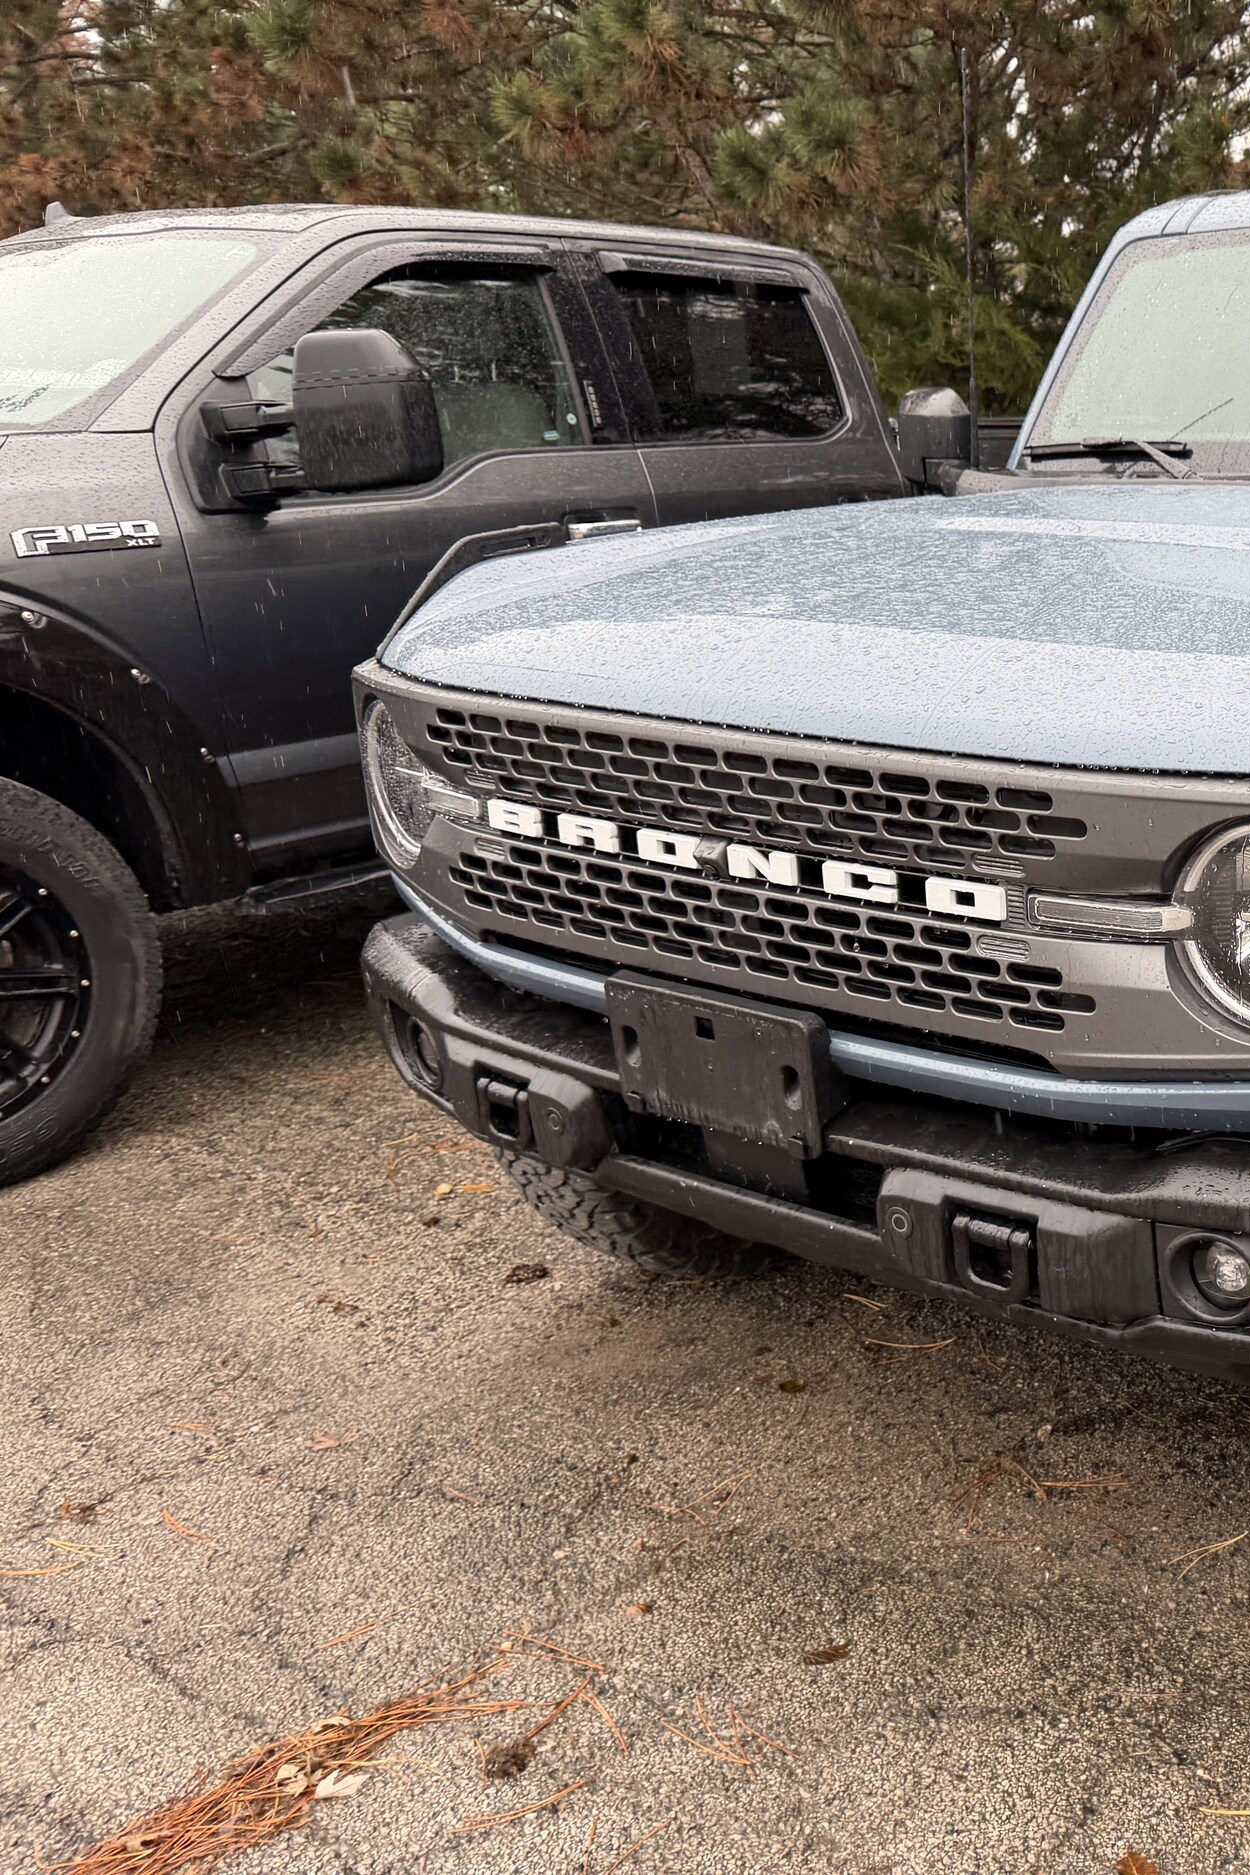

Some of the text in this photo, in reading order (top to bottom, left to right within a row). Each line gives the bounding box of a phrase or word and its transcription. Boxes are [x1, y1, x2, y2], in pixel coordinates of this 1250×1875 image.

[10, 519, 160, 557] F150
[126, 538, 156, 547] XLT
[488, 797, 1008, 921] BRONCO
